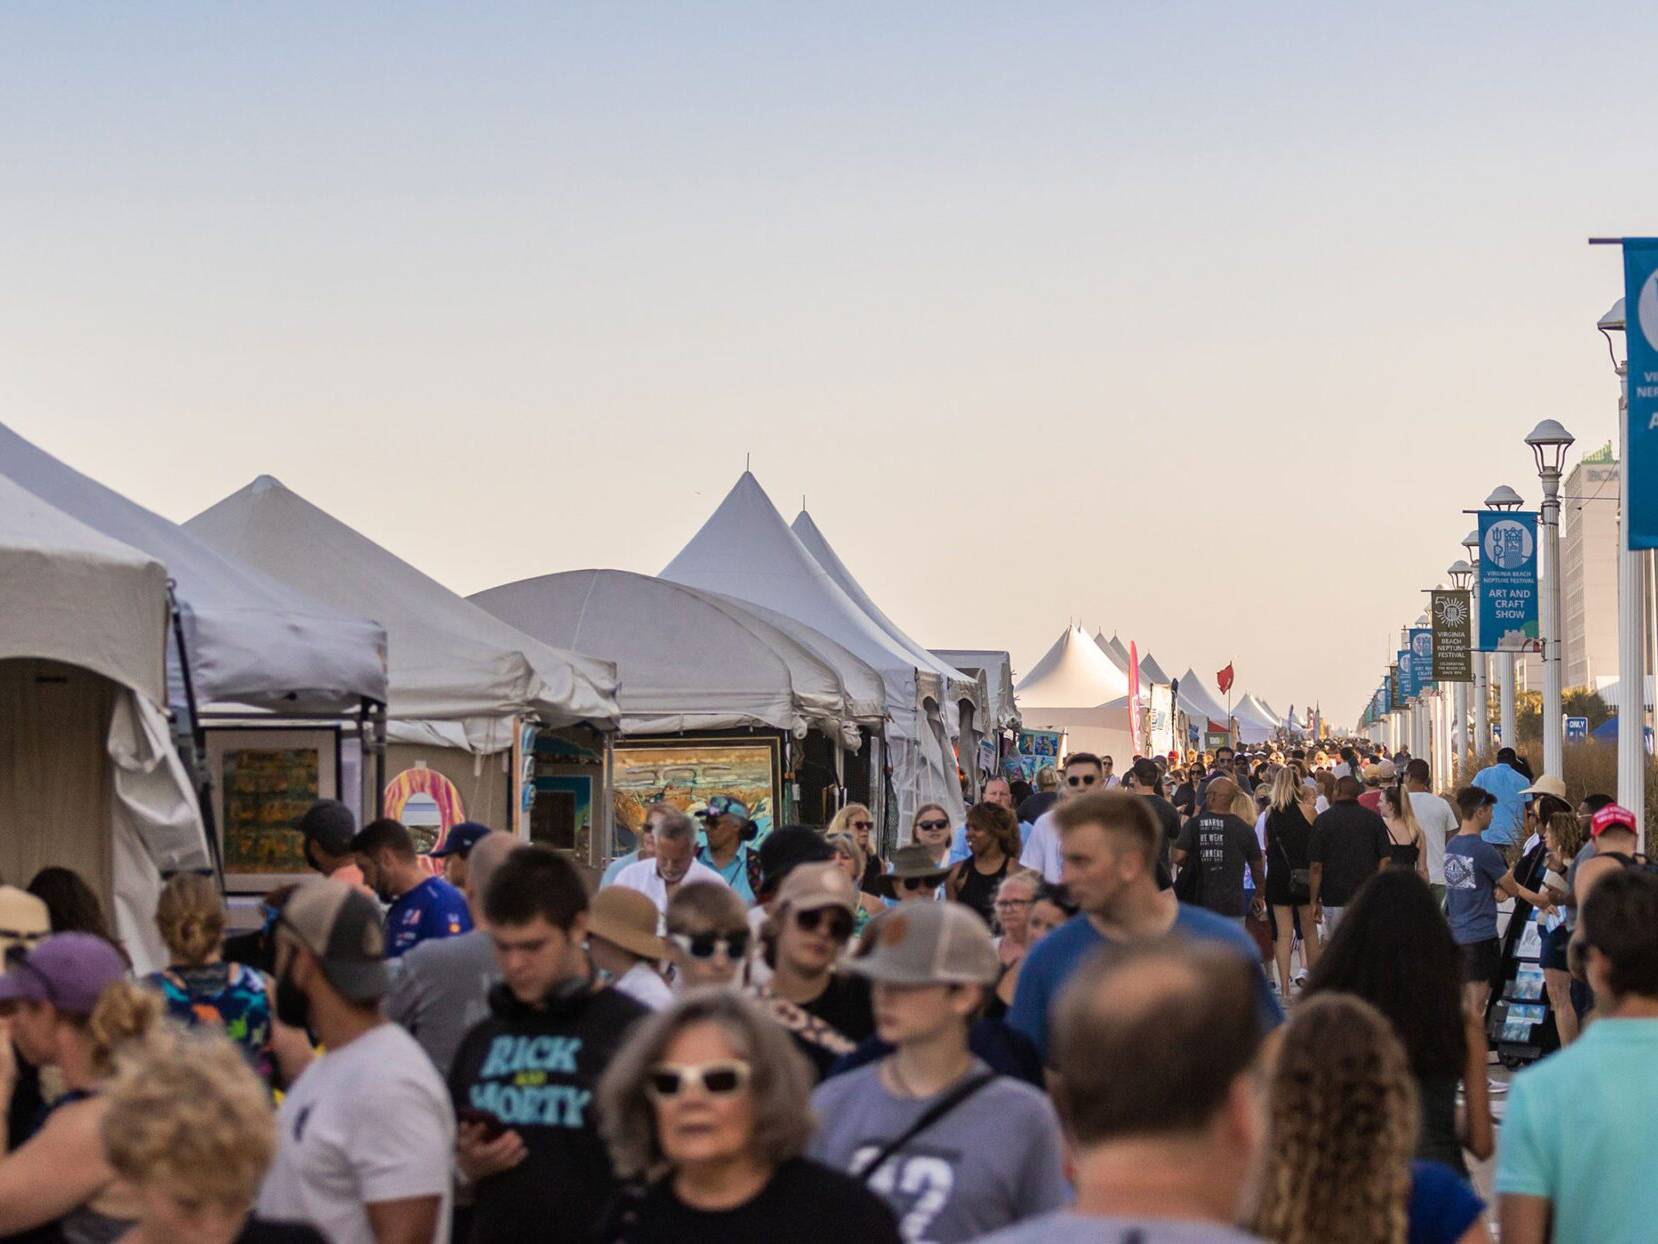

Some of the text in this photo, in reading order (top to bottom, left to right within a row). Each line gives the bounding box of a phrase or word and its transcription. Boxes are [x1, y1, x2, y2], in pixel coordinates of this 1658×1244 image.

[1488, 589, 1531, 598] ART AND
[1495, 600, 1525, 608] CRAFT
[1495, 610, 1525, 619] SHOW
[1569, 720, 1585, 729] ONLY
[480, 1034, 583, 1079] RICK
